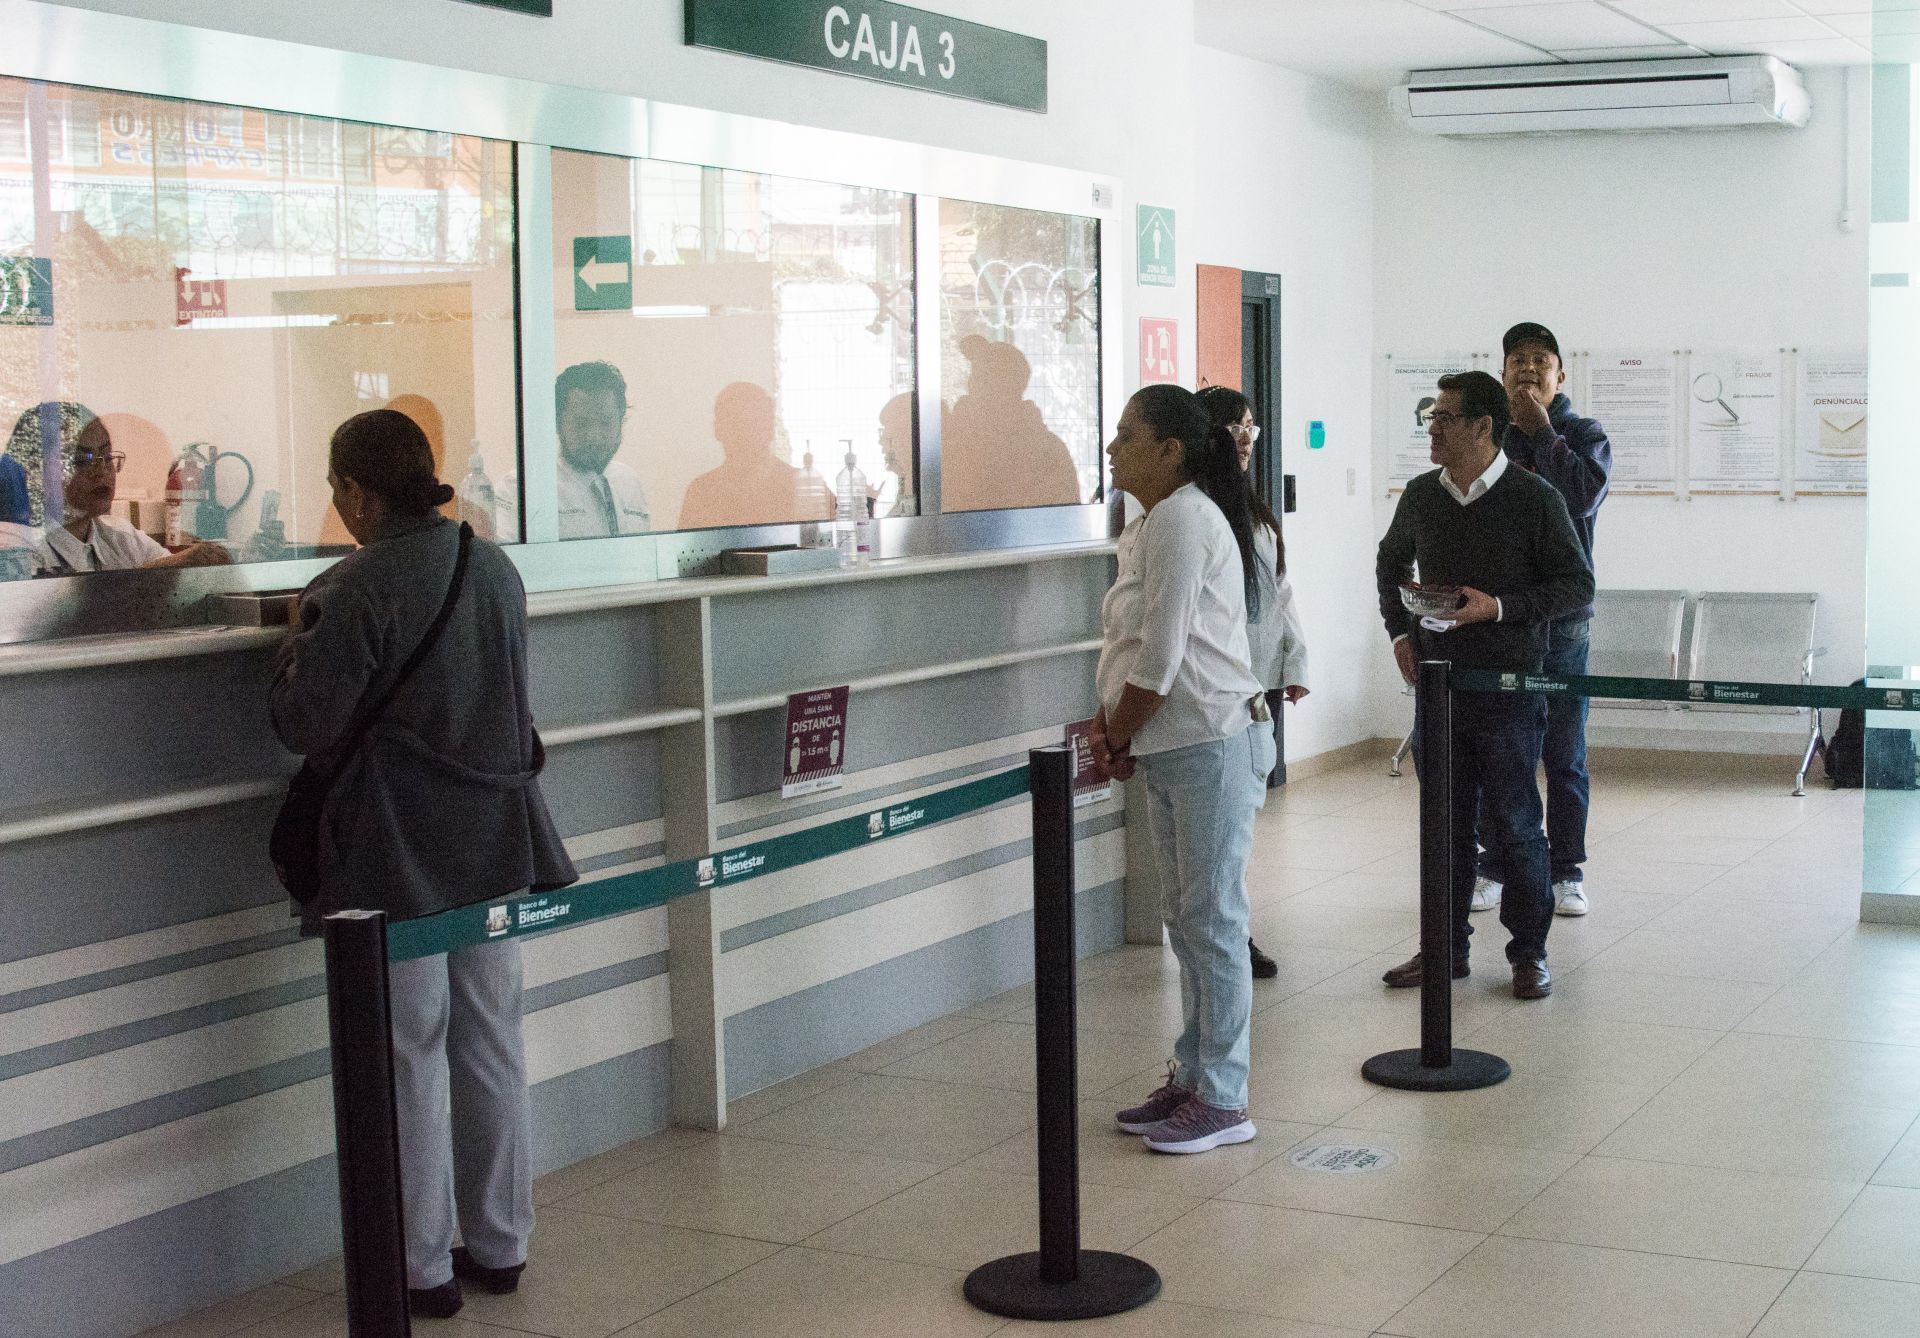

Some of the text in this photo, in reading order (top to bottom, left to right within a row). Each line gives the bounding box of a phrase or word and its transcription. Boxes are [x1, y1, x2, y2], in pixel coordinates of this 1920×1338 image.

[824, 5, 956, 79] CAJA 3
[179, 309, 225, 320] EXTINTOR
[1525, 680, 1568, 690] Bienestar
[1714, 689, 1760, 699] Bienestar
[792, 714, 842, 734] DISTANCIA
[813, 735, 821, 743] DE
[889, 808, 902, 816] Banco
[889, 809, 925, 827] Bienestar
[722, 850, 747, 862] Banco del
[722, 855, 766, 875] Bienestar
[518, 898, 548, 911] Banco del
[518, 904, 571, 925] Bienestar
